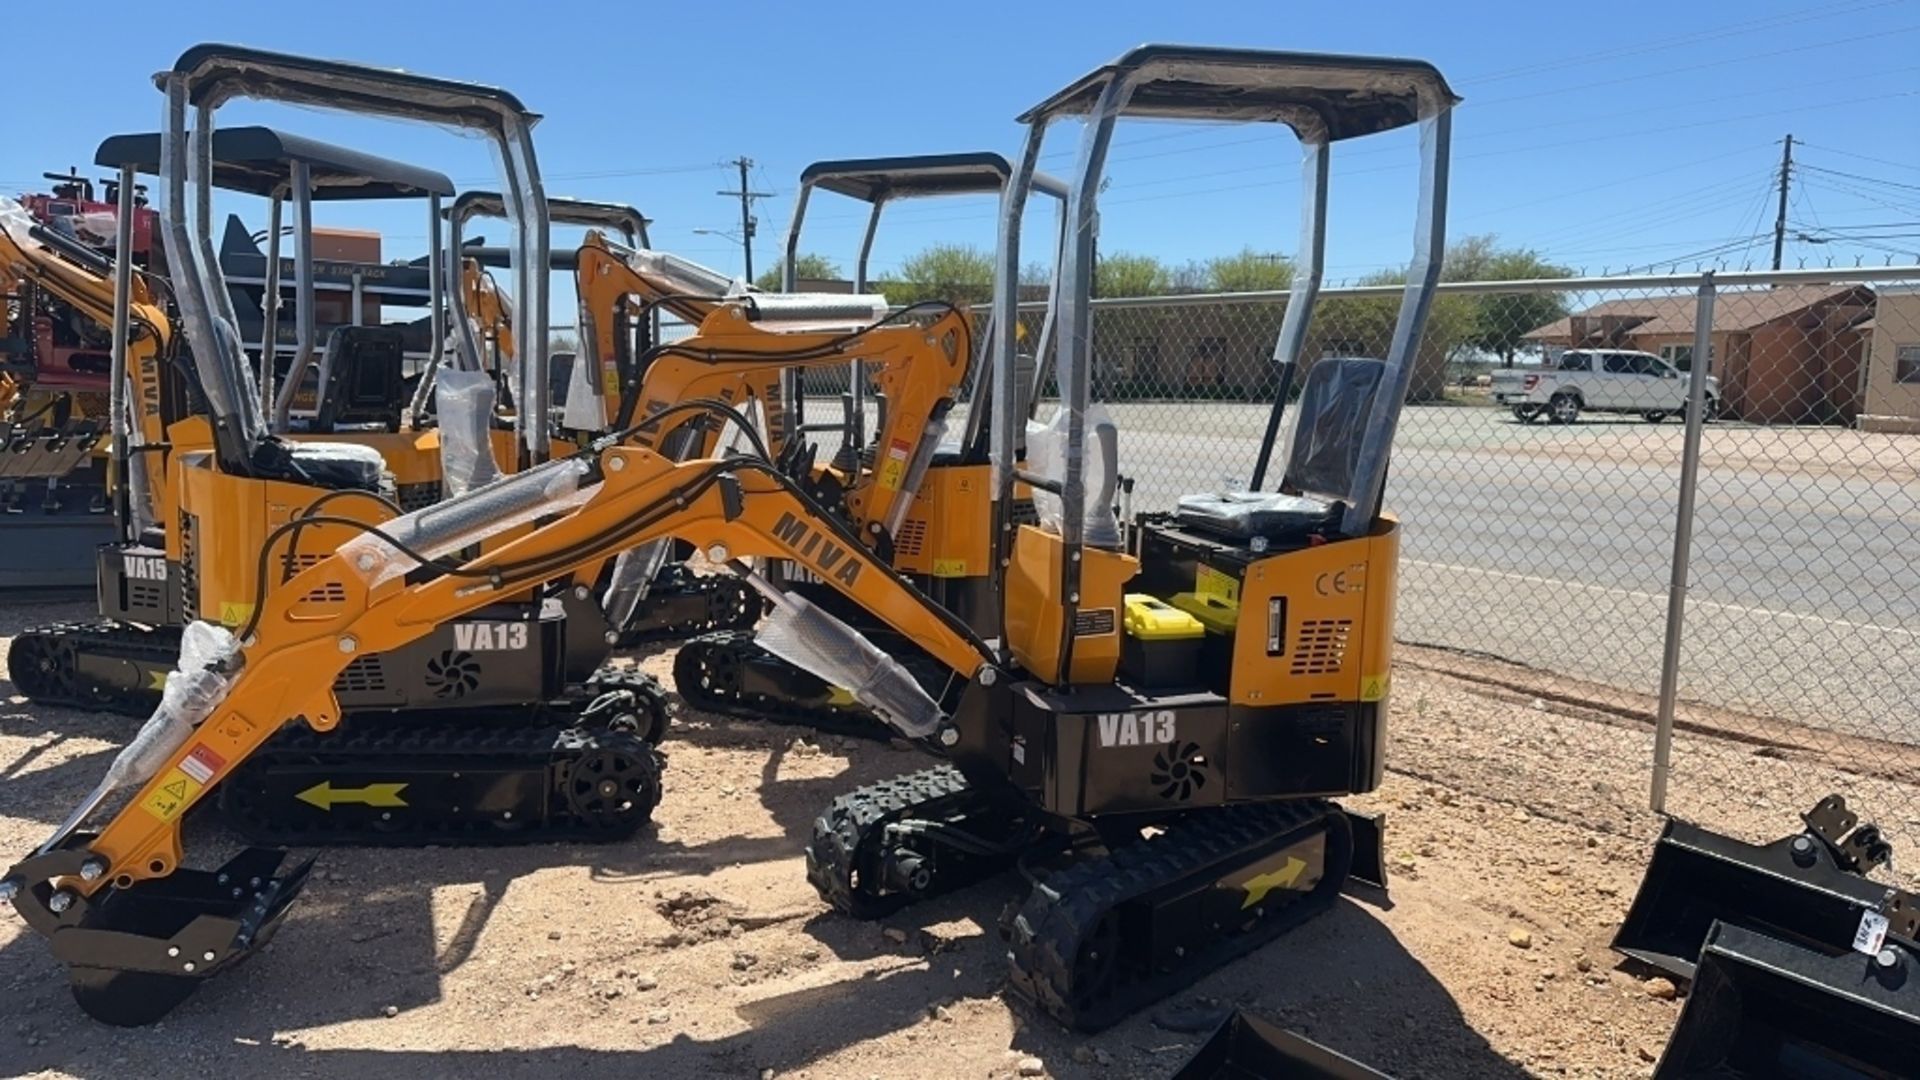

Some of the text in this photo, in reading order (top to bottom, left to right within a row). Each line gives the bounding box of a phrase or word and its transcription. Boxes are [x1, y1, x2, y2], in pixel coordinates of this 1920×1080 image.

[141, 356, 159, 416] MIVA
[766, 384, 785, 442] MIVA
[123, 556, 168, 581] VA15
[772, 511, 863, 589] MIVA
[454, 622, 528, 651] VA13
[1098, 710, 1176, 747] VA13
